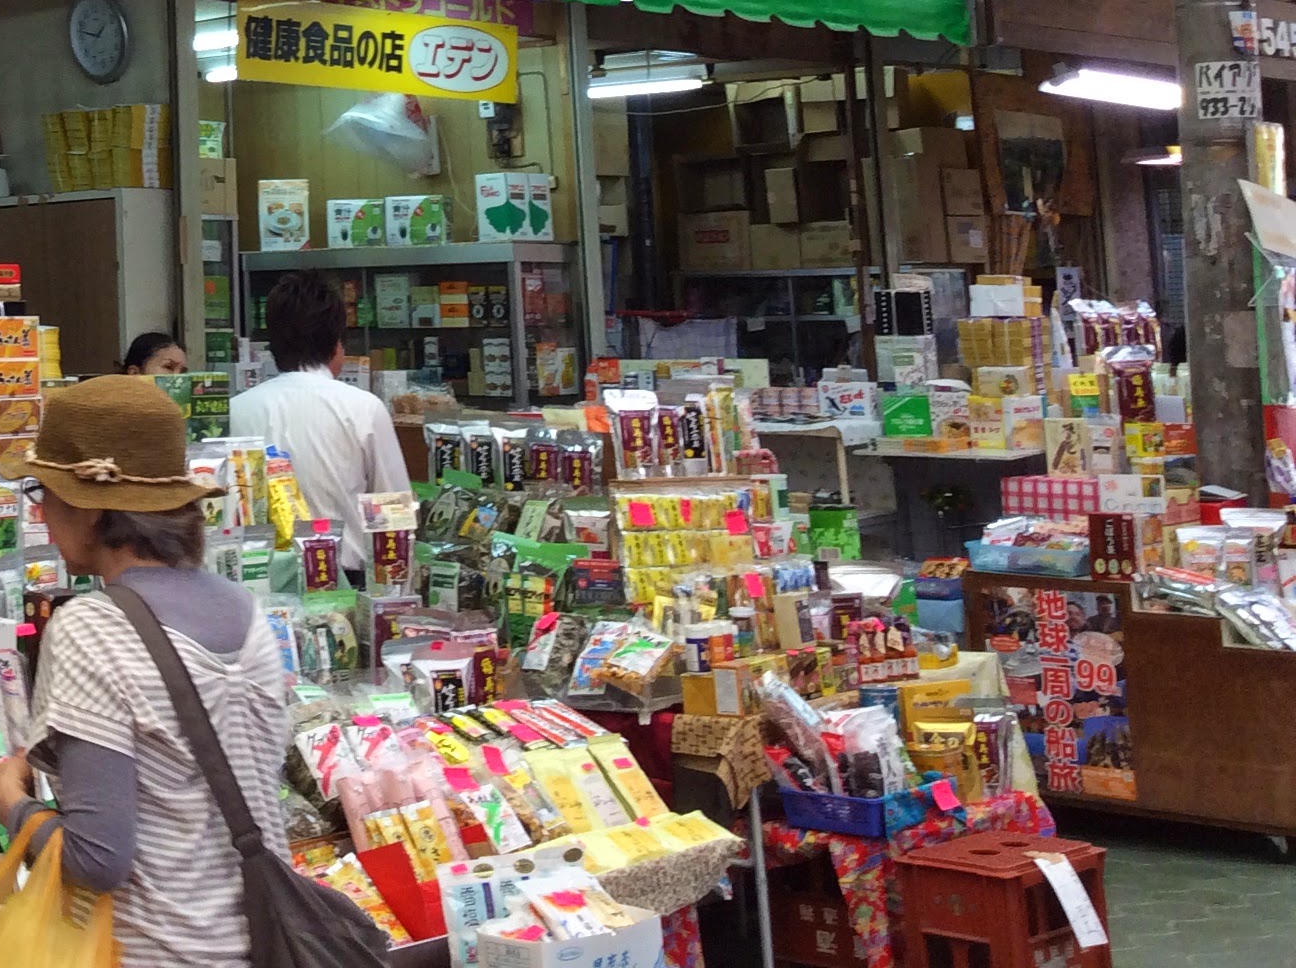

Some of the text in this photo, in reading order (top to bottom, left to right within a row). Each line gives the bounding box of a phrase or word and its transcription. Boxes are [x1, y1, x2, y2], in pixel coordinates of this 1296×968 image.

[245, 15, 499, 82] 健康食品の店 エデン
[1035, 589, 1082, 793] 地球一周の船旅
[1075, 659, 1118, 696] 99
